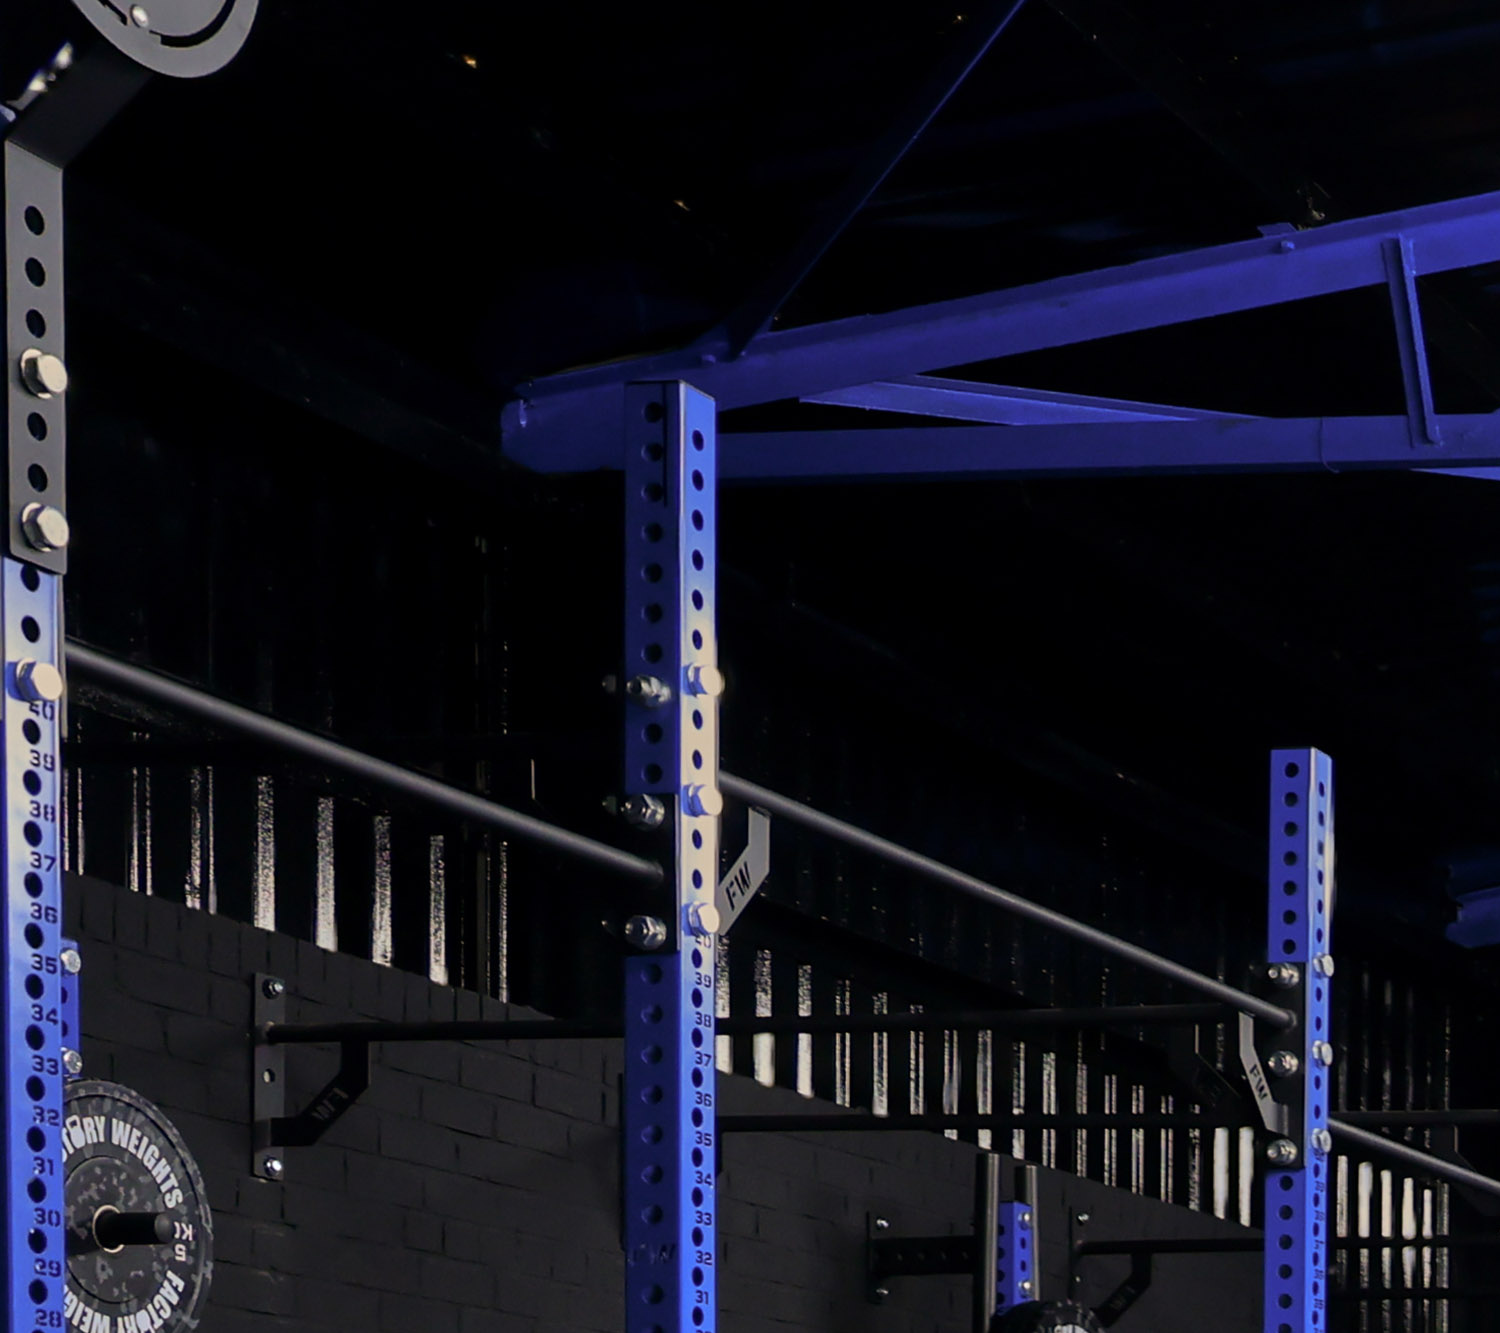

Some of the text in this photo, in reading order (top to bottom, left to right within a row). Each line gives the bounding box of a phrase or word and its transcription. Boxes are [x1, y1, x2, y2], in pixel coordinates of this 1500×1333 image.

[29, 751, 56, 773] 39
[29, 801, 57, 823] 38
[30, 851, 57, 873] 37
[726, 862, 751, 911] FW
[30, 902, 58, 925] 36
[31, 953, 58, 975] 35
[694, 971, 712, 989] 39
[31, 1003, 59, 1026] 34
[694, 1010, 712, 1029] 38
[32, 1054, 59, 1076] 33
[694, 1050, 712, 1067] 37
[694, 1090, 713, 1108] 36
[33, 1105, 60, 1127] 32
[695, 1130, 713, 1147] 35
[33, 1156, 54, 1177] 31
[111, 1117, 183, 1209] WEIGHTS
[695, 1170, 713, 1187] 34
[34, 1207, 61, 1228] 30
[695, 1209, 713, 1226] 33
[174, 1244, 187, 1261] 5
[695, 1249, 713, 1266] 32
[35, 1257, 62, 1278] 29
[695, 1289, 709, 1305] 31
[35, 1308, 62, 1329] 28
